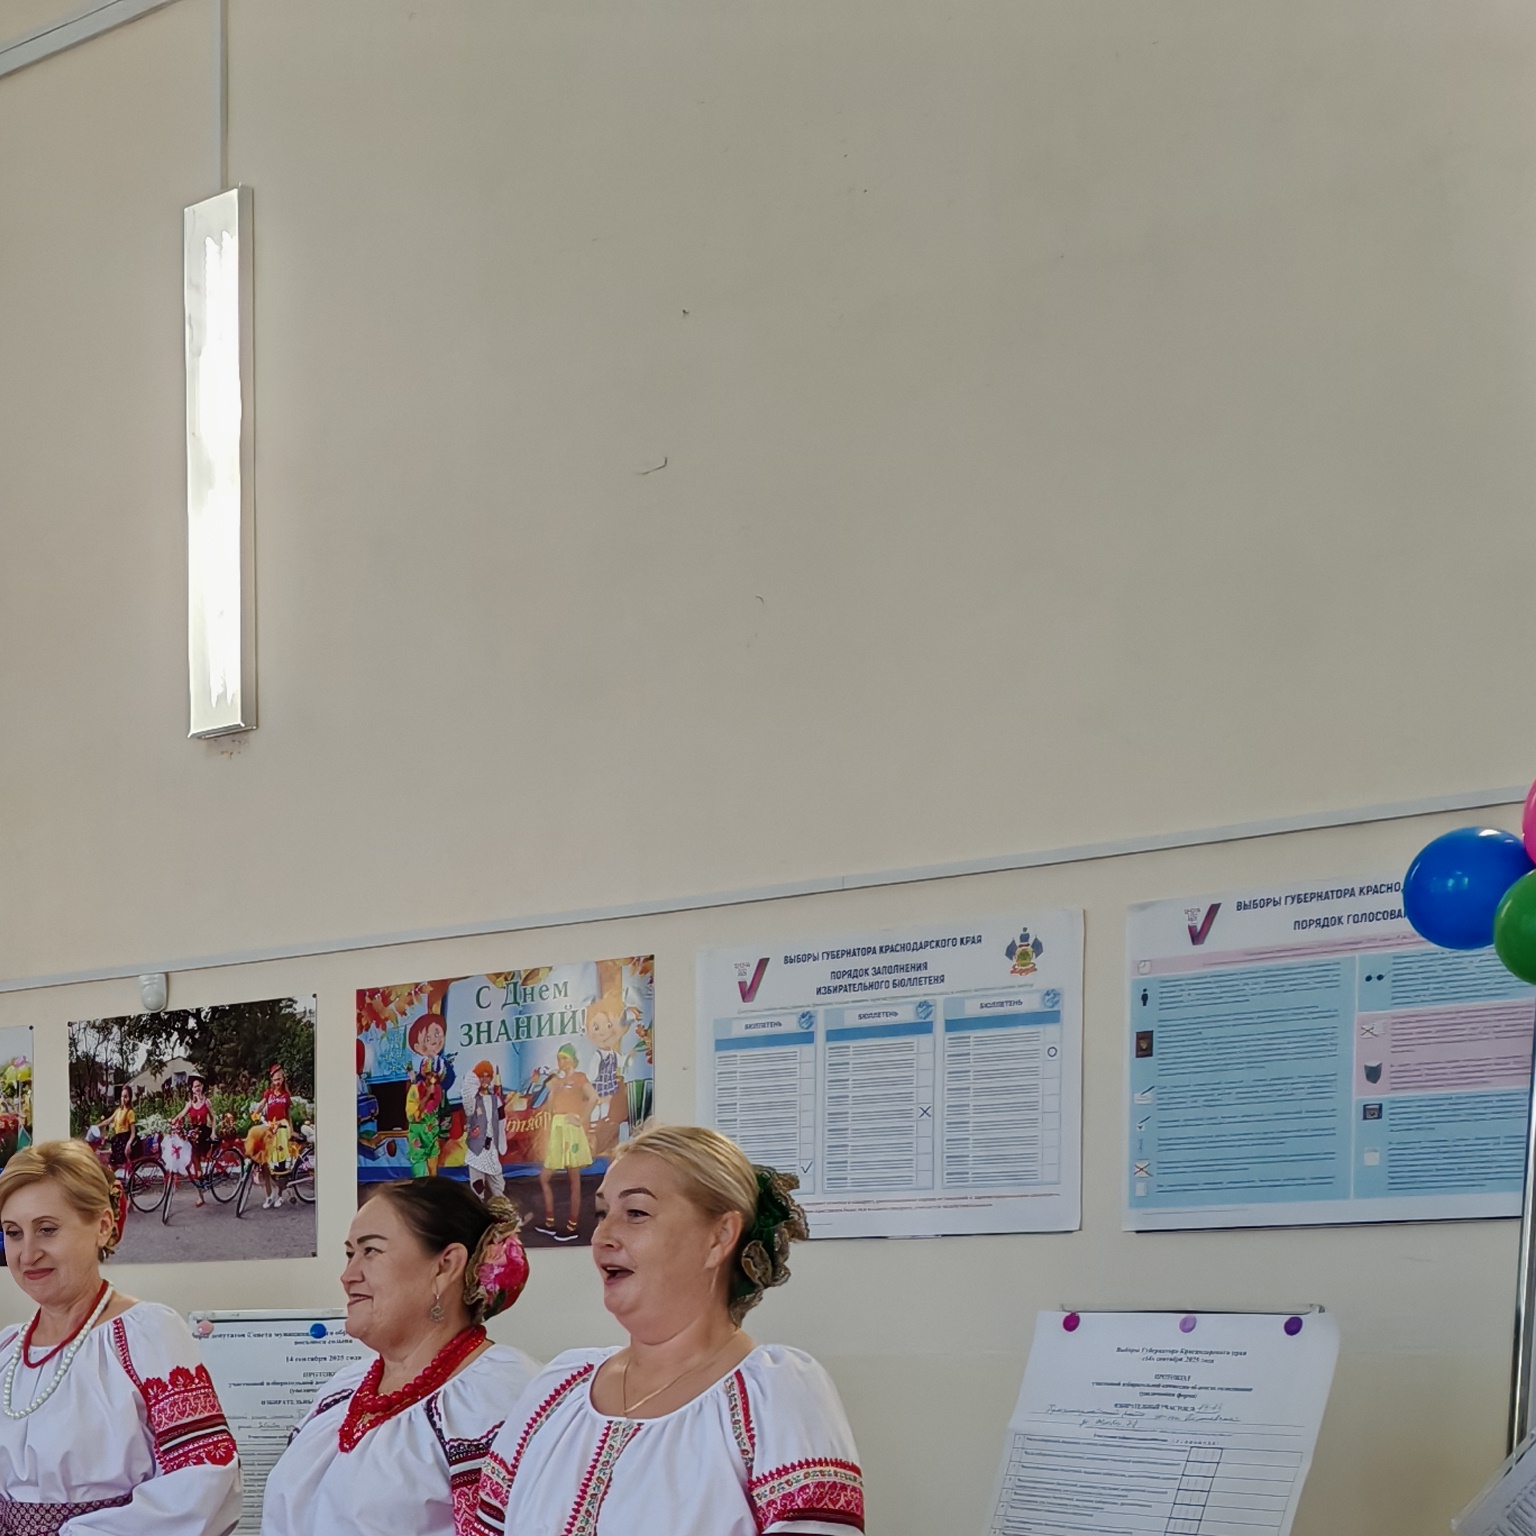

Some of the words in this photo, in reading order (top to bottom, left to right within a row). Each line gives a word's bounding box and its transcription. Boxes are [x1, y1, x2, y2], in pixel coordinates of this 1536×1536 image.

[1236, 897, 1282, 911] ВЫБОРЫ
[1284, 887, 1356, 906] ГУБЕРНАТОРА
[1358, 882, 1403, 897] КРАСНО
[1293, 915, 1344, 931] ПОРЯДОК
[1347, 908, 1407, 925] ГОЛОСОВА
[783, 953, 820, 965] ВЫБОРЫ
[821, 947, 877, 960] ГУБЕРНАТОРА
[878, 937, 958, 954] КРАСНОДАРСКОГО
[959, 935, 982, 946] КРАЯ
[816, 979, 890, 995] ИЗБИРАТЕЛЬНОГО
[892, 974, 945, 988] БЮЛЛЕТЕНЯ
[830, 967, 869, 980] ПОРЯДОК
[871, 962, 928, 976] ЗАПОЛНЕНИЯ
[475, 985, 492, 1009] С
[501, 980, 569, 1011] Днем
[459, 1004, 588, 1047] ЗНАНИЙ!
